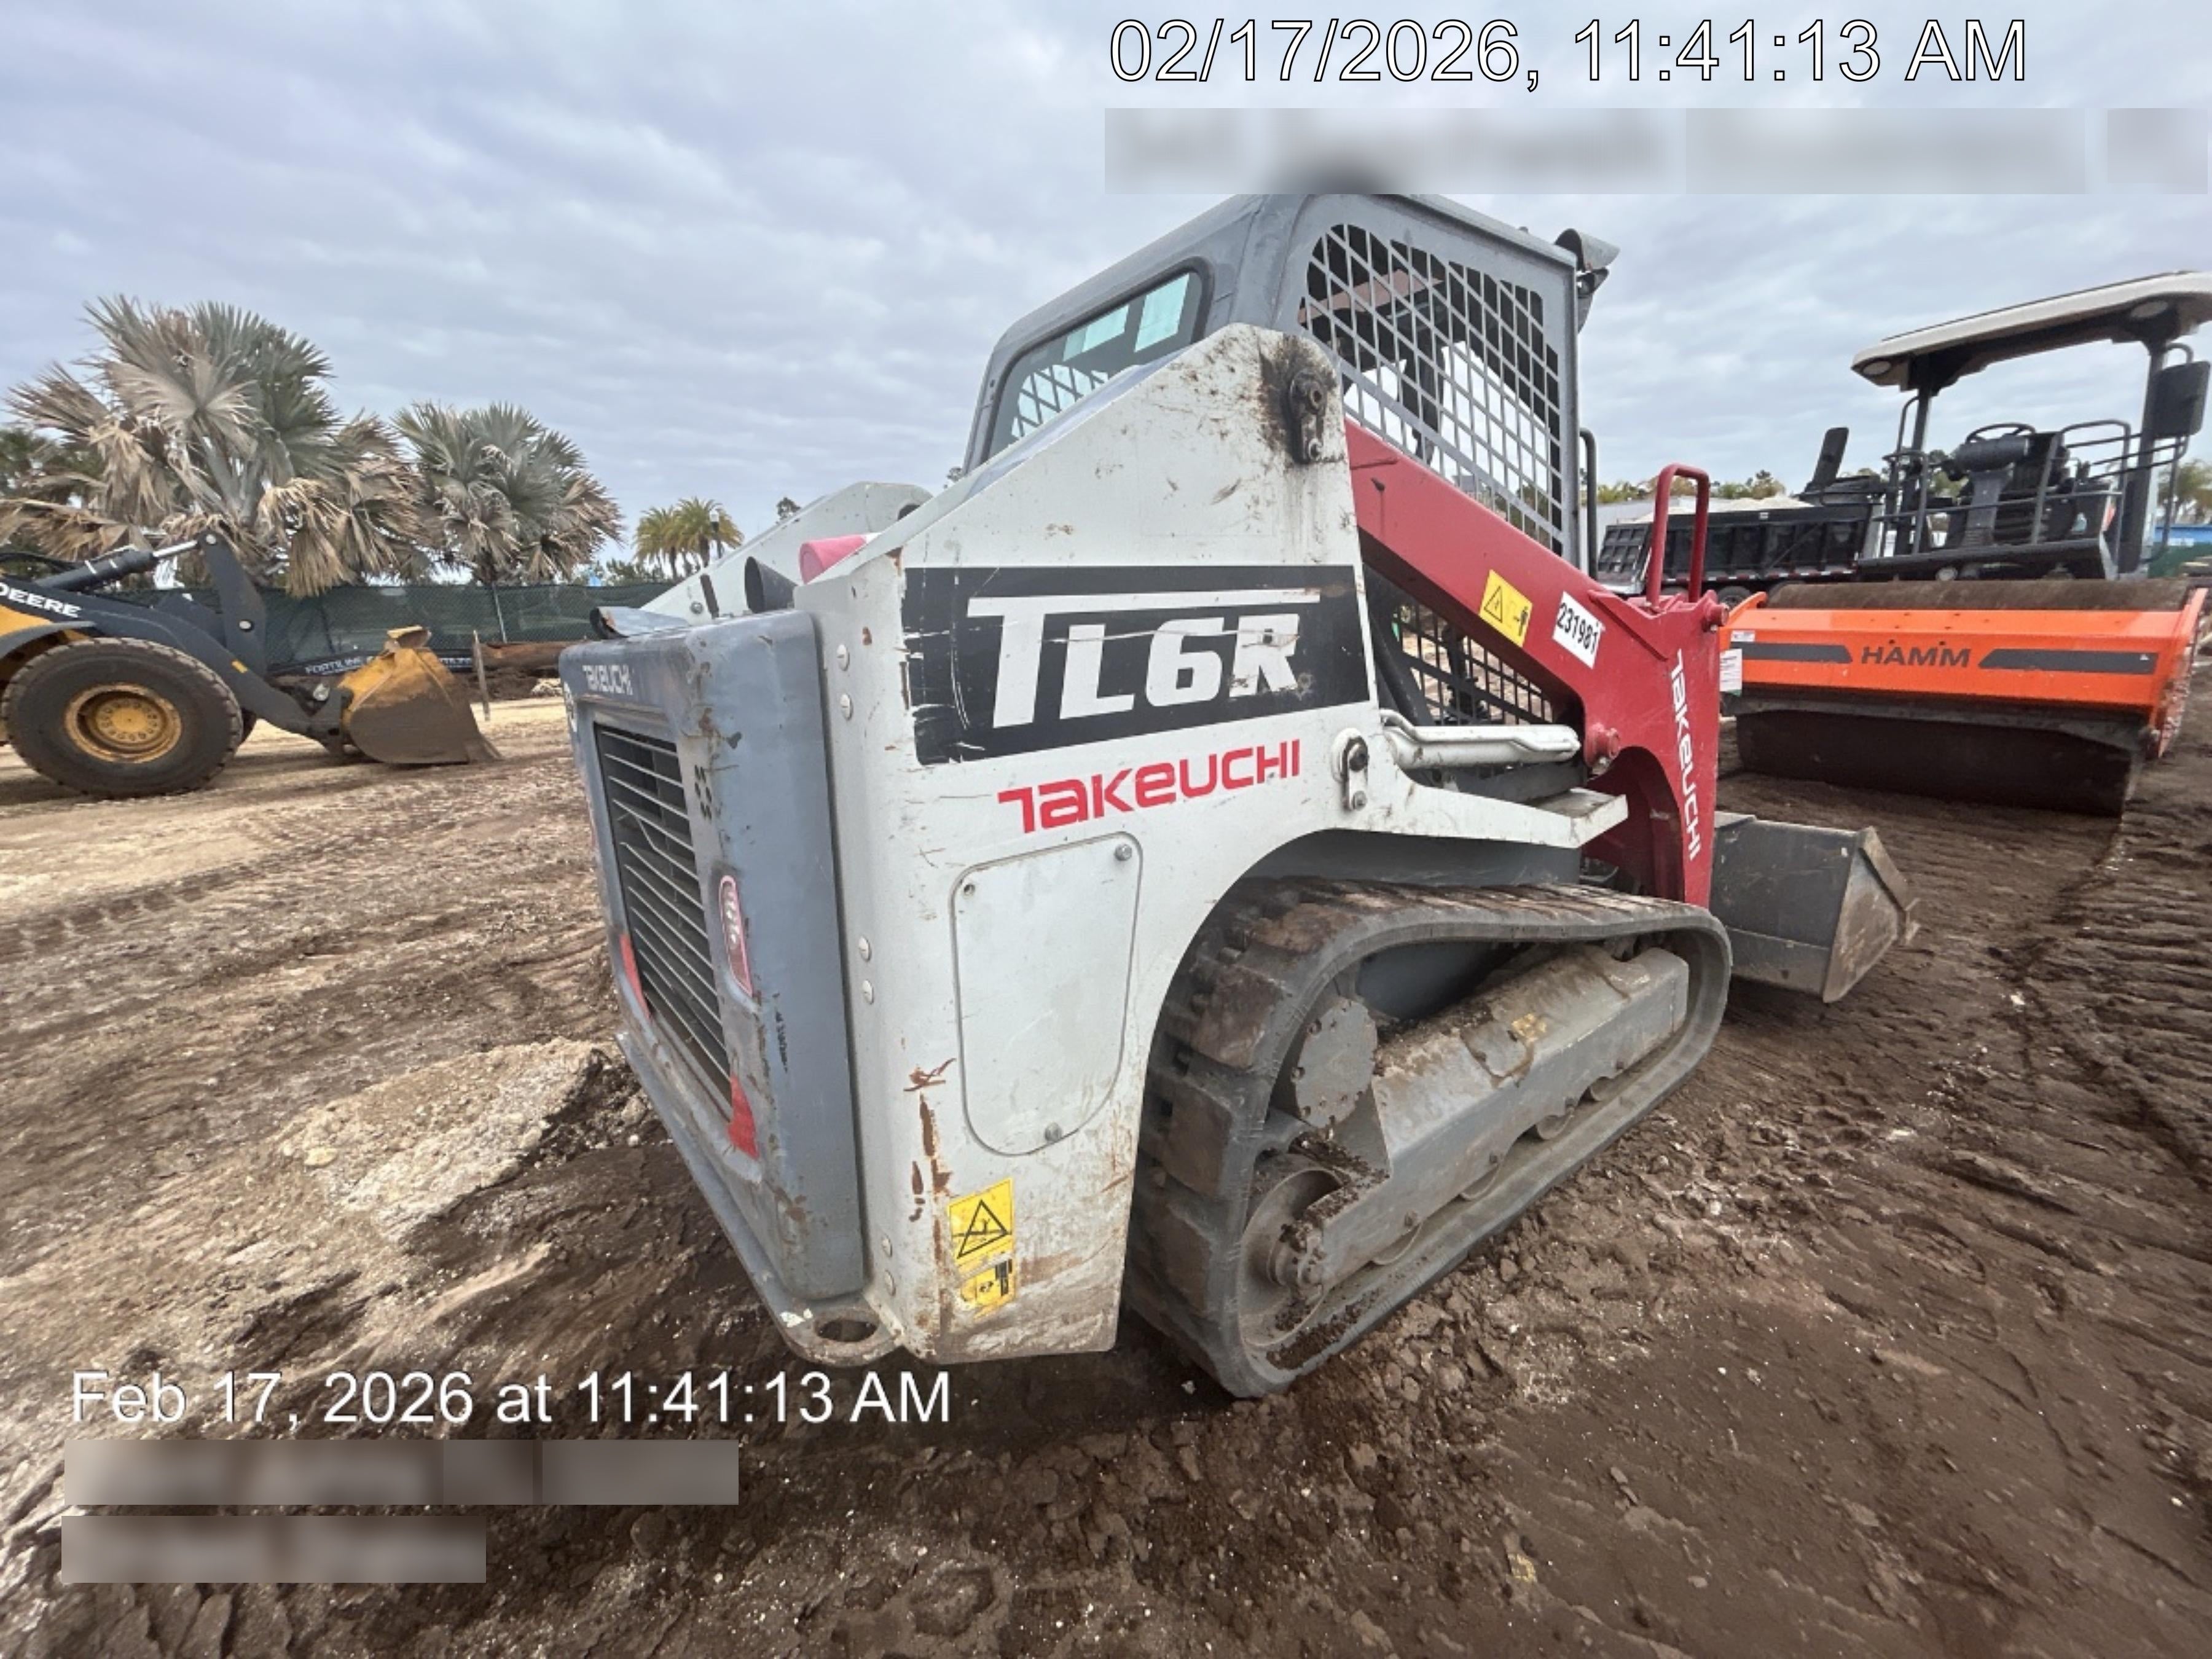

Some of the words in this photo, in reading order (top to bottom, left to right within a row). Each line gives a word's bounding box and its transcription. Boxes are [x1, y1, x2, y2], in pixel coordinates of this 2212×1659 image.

[967, 588, 1321, 728] TL6R
[1556, 602, 1599, 654] 231981
[1861, 646, 1972, 668] HAMM
[997, 739, 1300, 833] TAKEUCHI
[1671, 648, 1701, 861] TAKEUCHI
